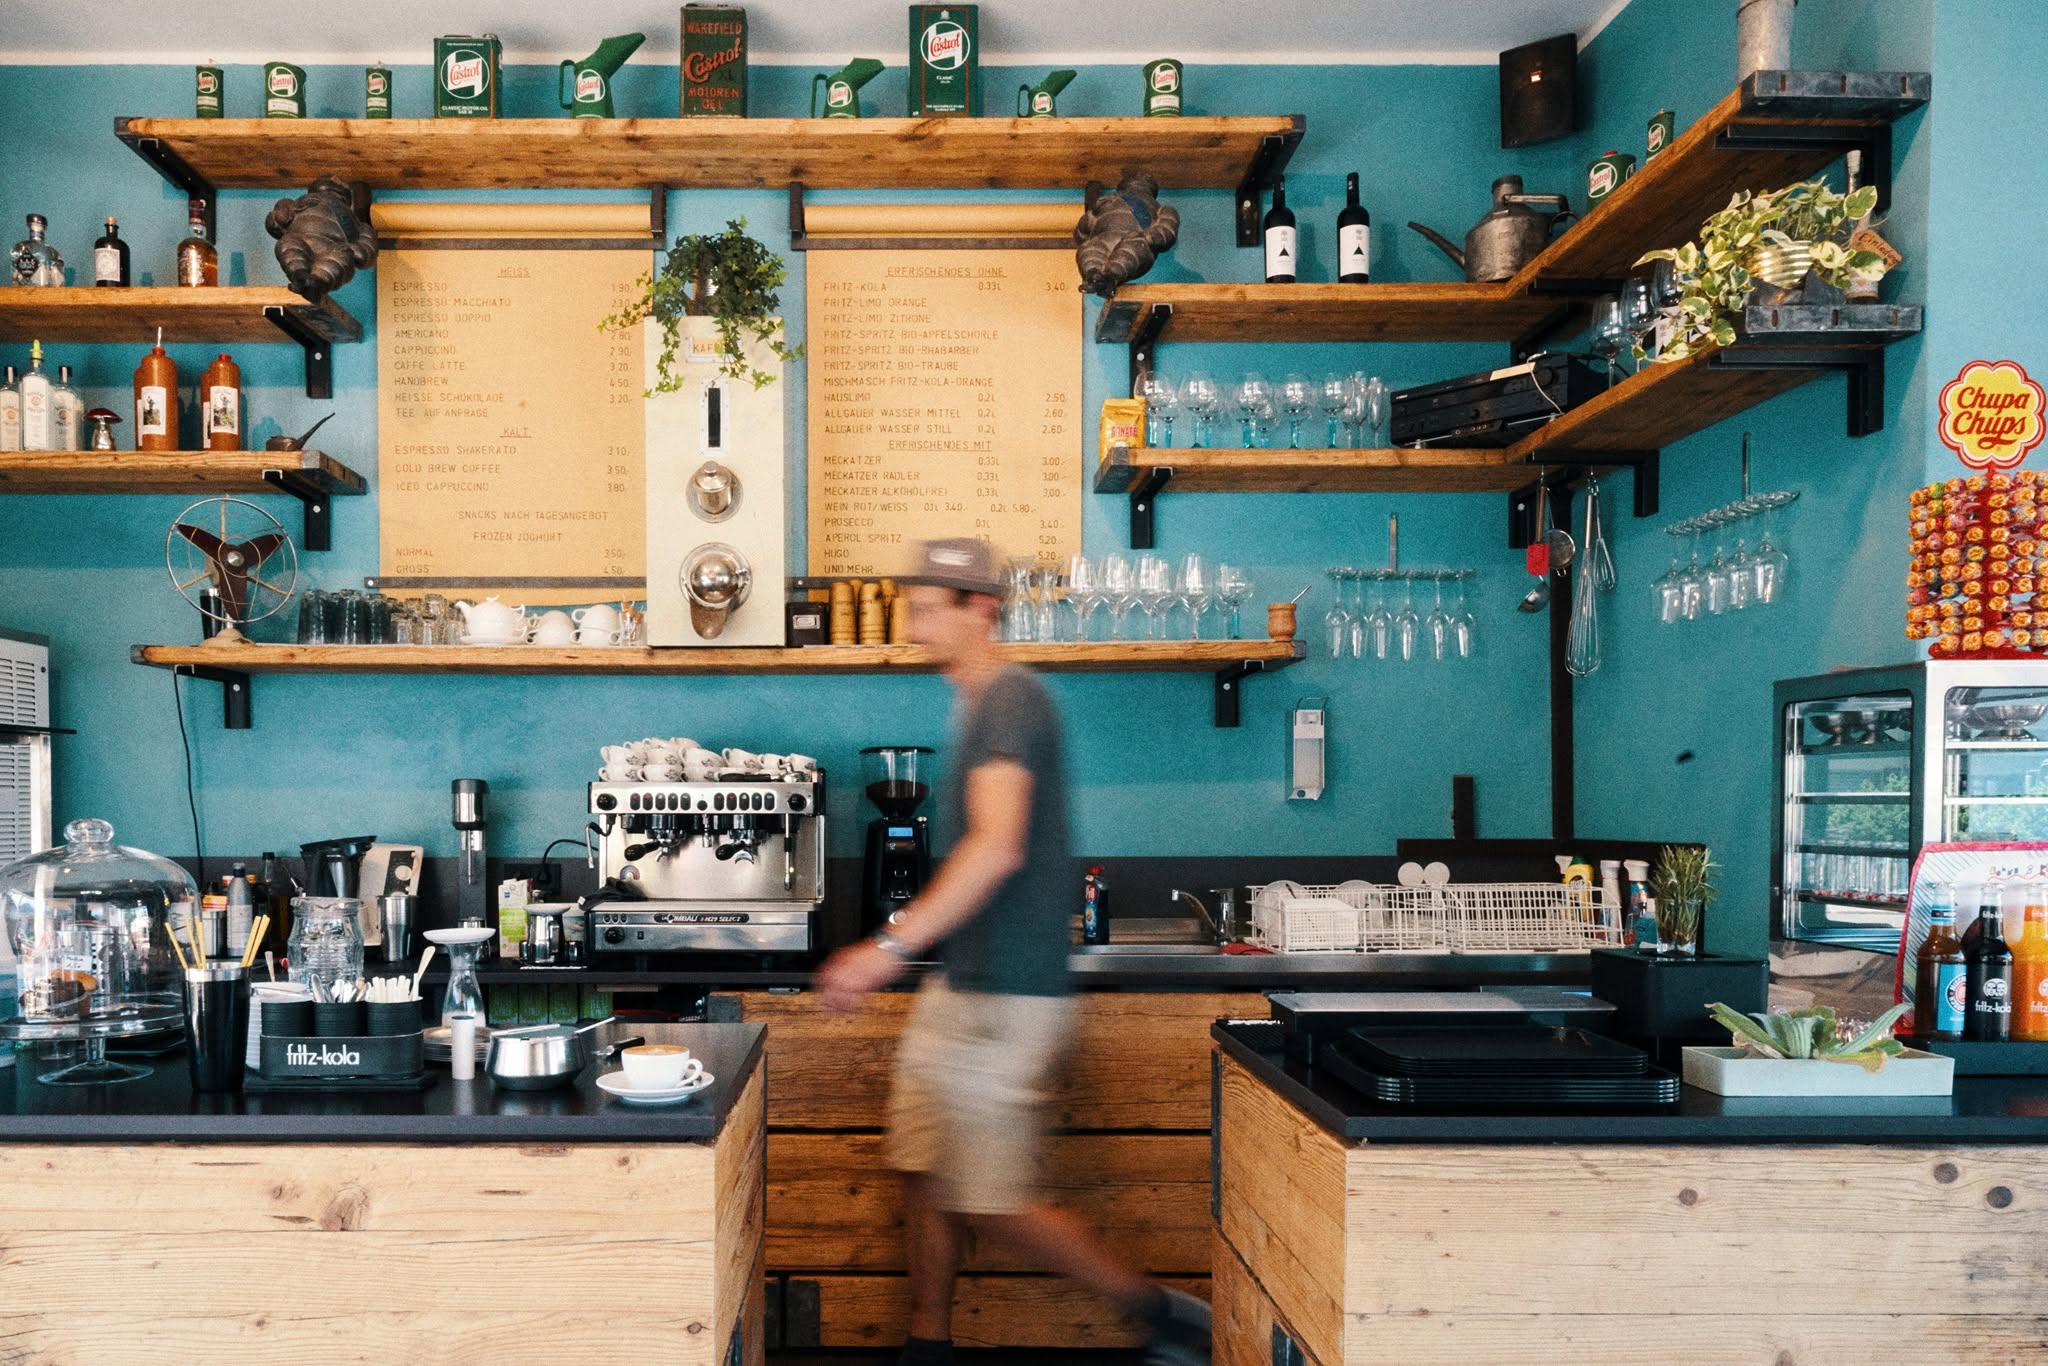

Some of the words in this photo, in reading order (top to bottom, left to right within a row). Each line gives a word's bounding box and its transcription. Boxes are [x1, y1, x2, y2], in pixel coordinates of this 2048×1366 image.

[687, 22, 742, 35] WAKEFIELD
[930, 31, 960, 57] Castrol
[685, 37, 742, 84] Castrol
[449, 60, 481, 87] Castrol
[688, 87, 740, 98] MOTOREN
[500, 267, 529, 276] HEISS
[886, 266, 971, 277] ERFRISCHENDES
[977, 266, 1004, 277] OHNE
[393, 282, 448, 292] ESPRESSO
[824, 282, 887, 292] FRITZ-KOLA
[393, 297, 448, 307] ESPRESSO
[453, 298, 512, 307] MACCHIATO
[824, 298, 882, 308] FRITZ-LIMO
[888, 298, 928, 308] ORANGE
[393, 313, 448, 323] ESPRESSO
[824, 313, 883, 323] FRITZ-LIMO
[890, 313, 931, 323] ZITRONE
[394, 329, 448, 339] AMERICANO
[824, 329, 895, 340] FRITZ-SPRITZ
[899, 329, 999, 340] BIO-APFELSCHORLE
[393, 345, 457, 355] CAPPUCCINO
[824, 345, 892, 355] FRITZ-SPRITZ
[898, 345, 980, 356] BIO-RHABARBER
[432, 361, 466, 370] LATTE
[824, 361, 892, 371] FRITZ-SPRITZ
[897, 361, 959, 371] BIO-TRAUBE
[393, 376, 449, 386] HANDBREW
[824, 377, 886, 387] MISCHMASCH
[890, 378, 993, 388] FRITZ-KOLA-ORANGE
[394, 392, 433, 402] HEISSE
[439, 392, 505, 403] SCHOKOLADE
[824, 393, 871, 402] HAUSLIMO
[1956, 386, 2031, 415] Chupa
[395, 408, 415, 418] TEE
[423, 408, 442, 418] AUF
[444, 408, 489, 418] ANFRAGE
[880, 408, 921, 418] WASSER
[926, 409, 962, 419] MITTEL
[503, 427, 529, 437] KALT
[879, 424, 920, 434] WASSER
[926, 424, 953, 434] STILL
[1952, 411, 2028, 450] Chups
[394, 445, 450, 455] ESPRESSO
[456, 445, 517, 455] SHAKERATO
[888, 440, 969, 450] ERFRISCHENDES
[973, 440, 992, 449] MIT
[824, 456, 882, 465] MECKATZER
[395, 464, 422, 474] COLD
[428, 464, 457, 474] BREW
[462, 464, 502, 474] COFFEE
[824, 471, 878, 481] MECKATZER
[883, 471, 920, 481] RADLER
[396, 482, 420, 491] ICED
[426, 482, 489, 492] CAPPUCCINO
[824, 487, 878, 497] MECKATZER
[881, 487, 949, 497] ALKOHOLFREI
[824, 502, 848, 512] WEIN
[853, 502, 908, 512] ROT/WEISS
[458, 510, 497, 520] SNACKS
[503, 511, 530, 520] NACH
[535, 511, 609, 521] TAGESANGEBOT
[824, 518, 874, 528] PROSECCO
[473, 532, 513, 542] FROZEN
[517, 532, 563, 542] JOGHURT
[824, 533, 862, 543] APEROL
[868, 533, 902, 543] SPRITZ
[395, 548, 435, 558] NORMAL
[824, 549, 849, 559] HUGO
[395, 564, 430, 574] GROSS
[824, 565, 844, 574] UND
[1975, 999, 2012, 1014] fritz-kola
[286, 1043, 361, 1067] fritz-kola
